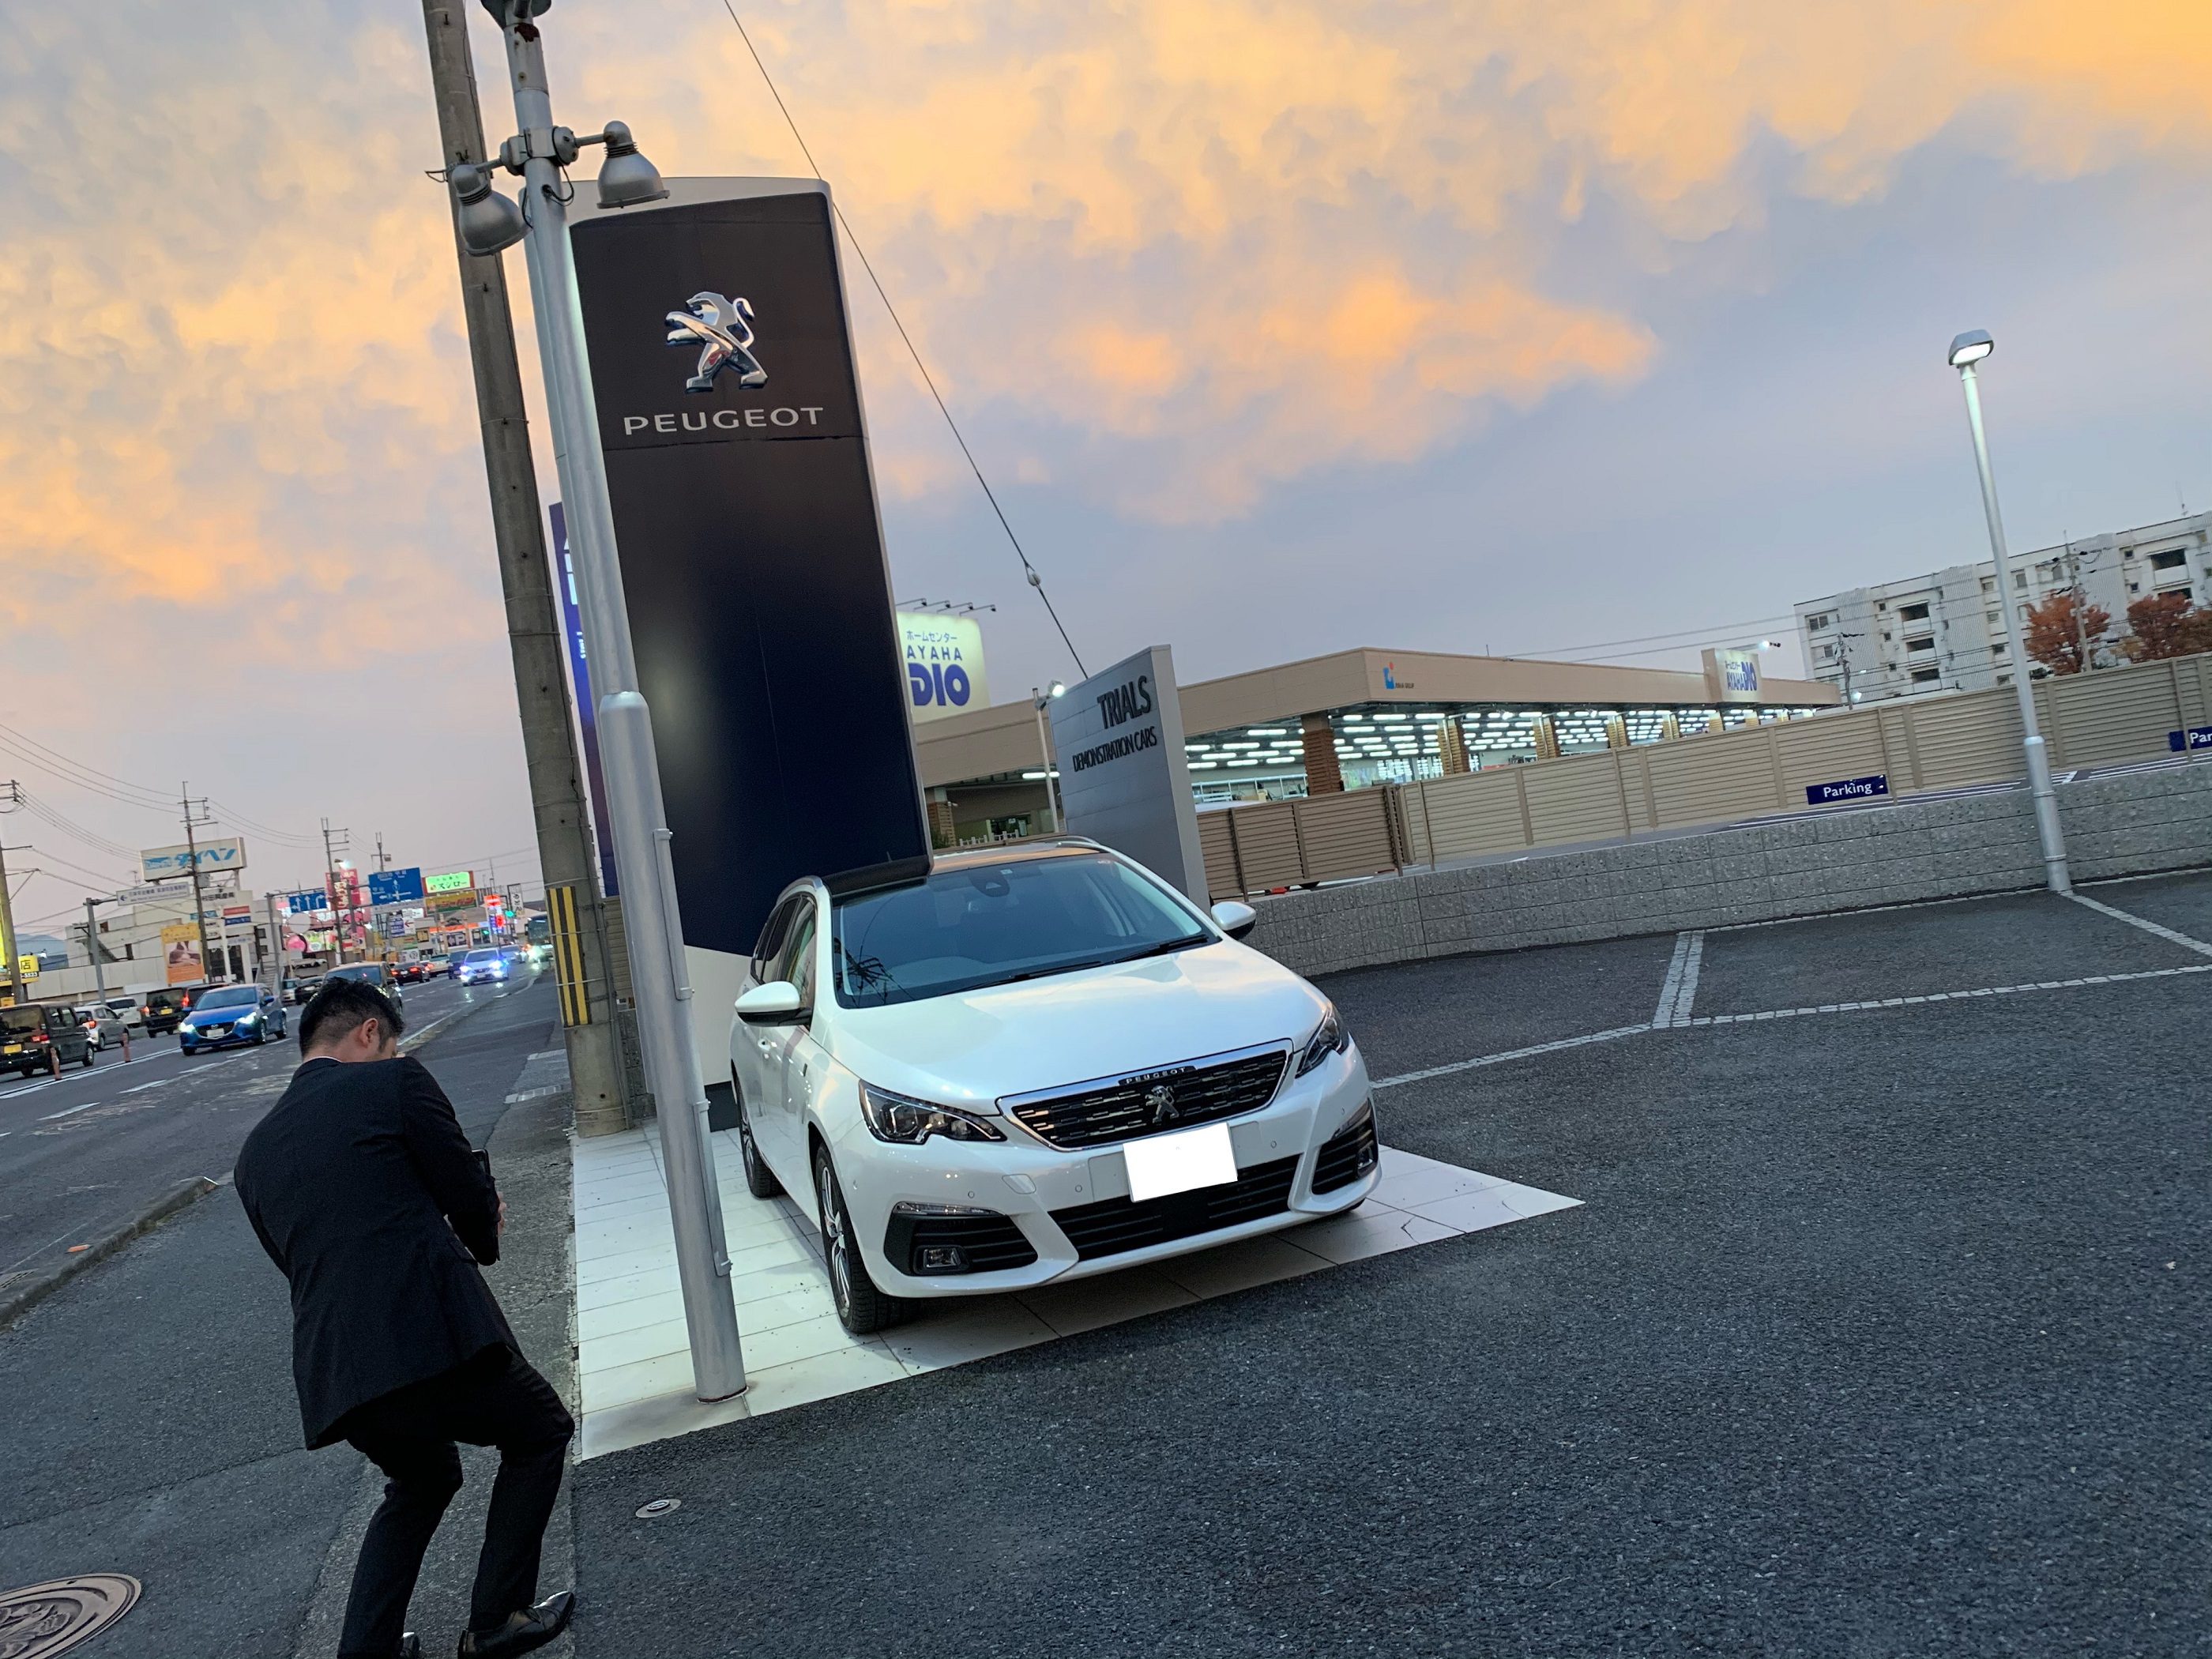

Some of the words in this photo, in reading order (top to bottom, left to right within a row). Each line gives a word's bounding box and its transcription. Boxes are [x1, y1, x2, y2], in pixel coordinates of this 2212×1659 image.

[623, 407, 823, 435] PEUGEOT
[906, 630, 957, 643] ホームセンター
[906, 644, 963, 661] AYAHA
[907, 662, 971, 706] DIO
[1097, 675, 1152, 729] TRIALS
[1072, 733, 1135, 772] DEMONSTRATION
[1134, 725, 1157, 751] CARS
[1823, 783, 1873, 798] Parking
[438, 881, 467, 890] スシロー
[21, 959, 32, 970] 店
[1126, 1067, 1186, 1085] PEUGEOT
